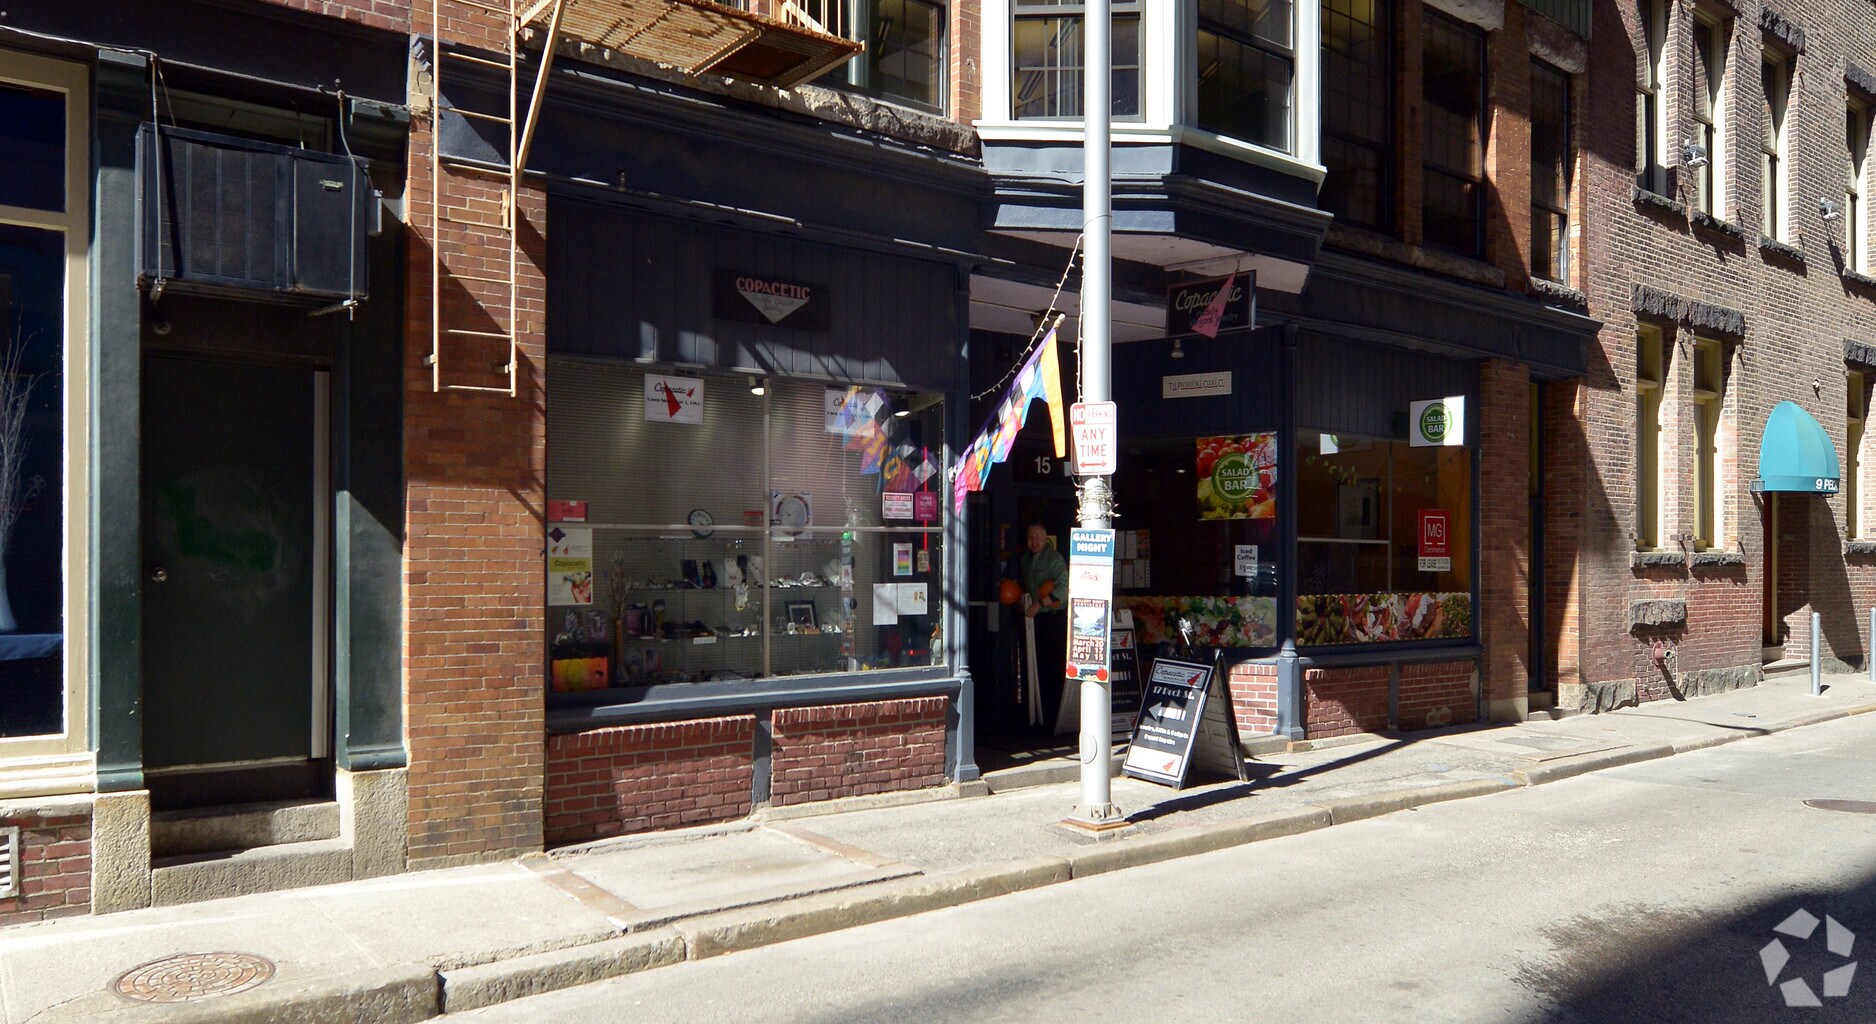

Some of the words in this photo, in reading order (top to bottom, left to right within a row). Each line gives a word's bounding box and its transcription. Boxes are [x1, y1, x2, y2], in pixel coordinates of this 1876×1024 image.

[735, 276, 810, 300] COPACETIC
[1175, 284, 1242, 314] Copacic
[1073, 407, 1085, 422] NO
[1087, 407, 1112, 419] PARKING
[1426, 415, 1447, 423] SALAD
[1427, 424, 1444, 433] BAR
[1081, 428, 1105, 441] ANY
[1080, 444, 1107, 457] TIME
[1035, 456, 1051, 474] 15
[1221, 467, 1250, 477] SALAD
[1224, 480, 1248, 491] BAR
[1815, 478, 1823, 490] 9
[1427, 523, 1443, 538] MG
[1073, 532, 1112, 543] GALLERY
[1076, 543, 1107, 553] NIGHT
[553, 560, 587, 569] Copacetic
[1072, 639, 1095, 648] March
[1094, 640, 1104, 648] 20
[1072, 645, 1091, 654] April
[1072, 653, 1091, 661] May
[1094, 653, 1104, 661] 15
[1153, 685, 1163, 695] 17
[1183, 690, 1195, 701] St.
